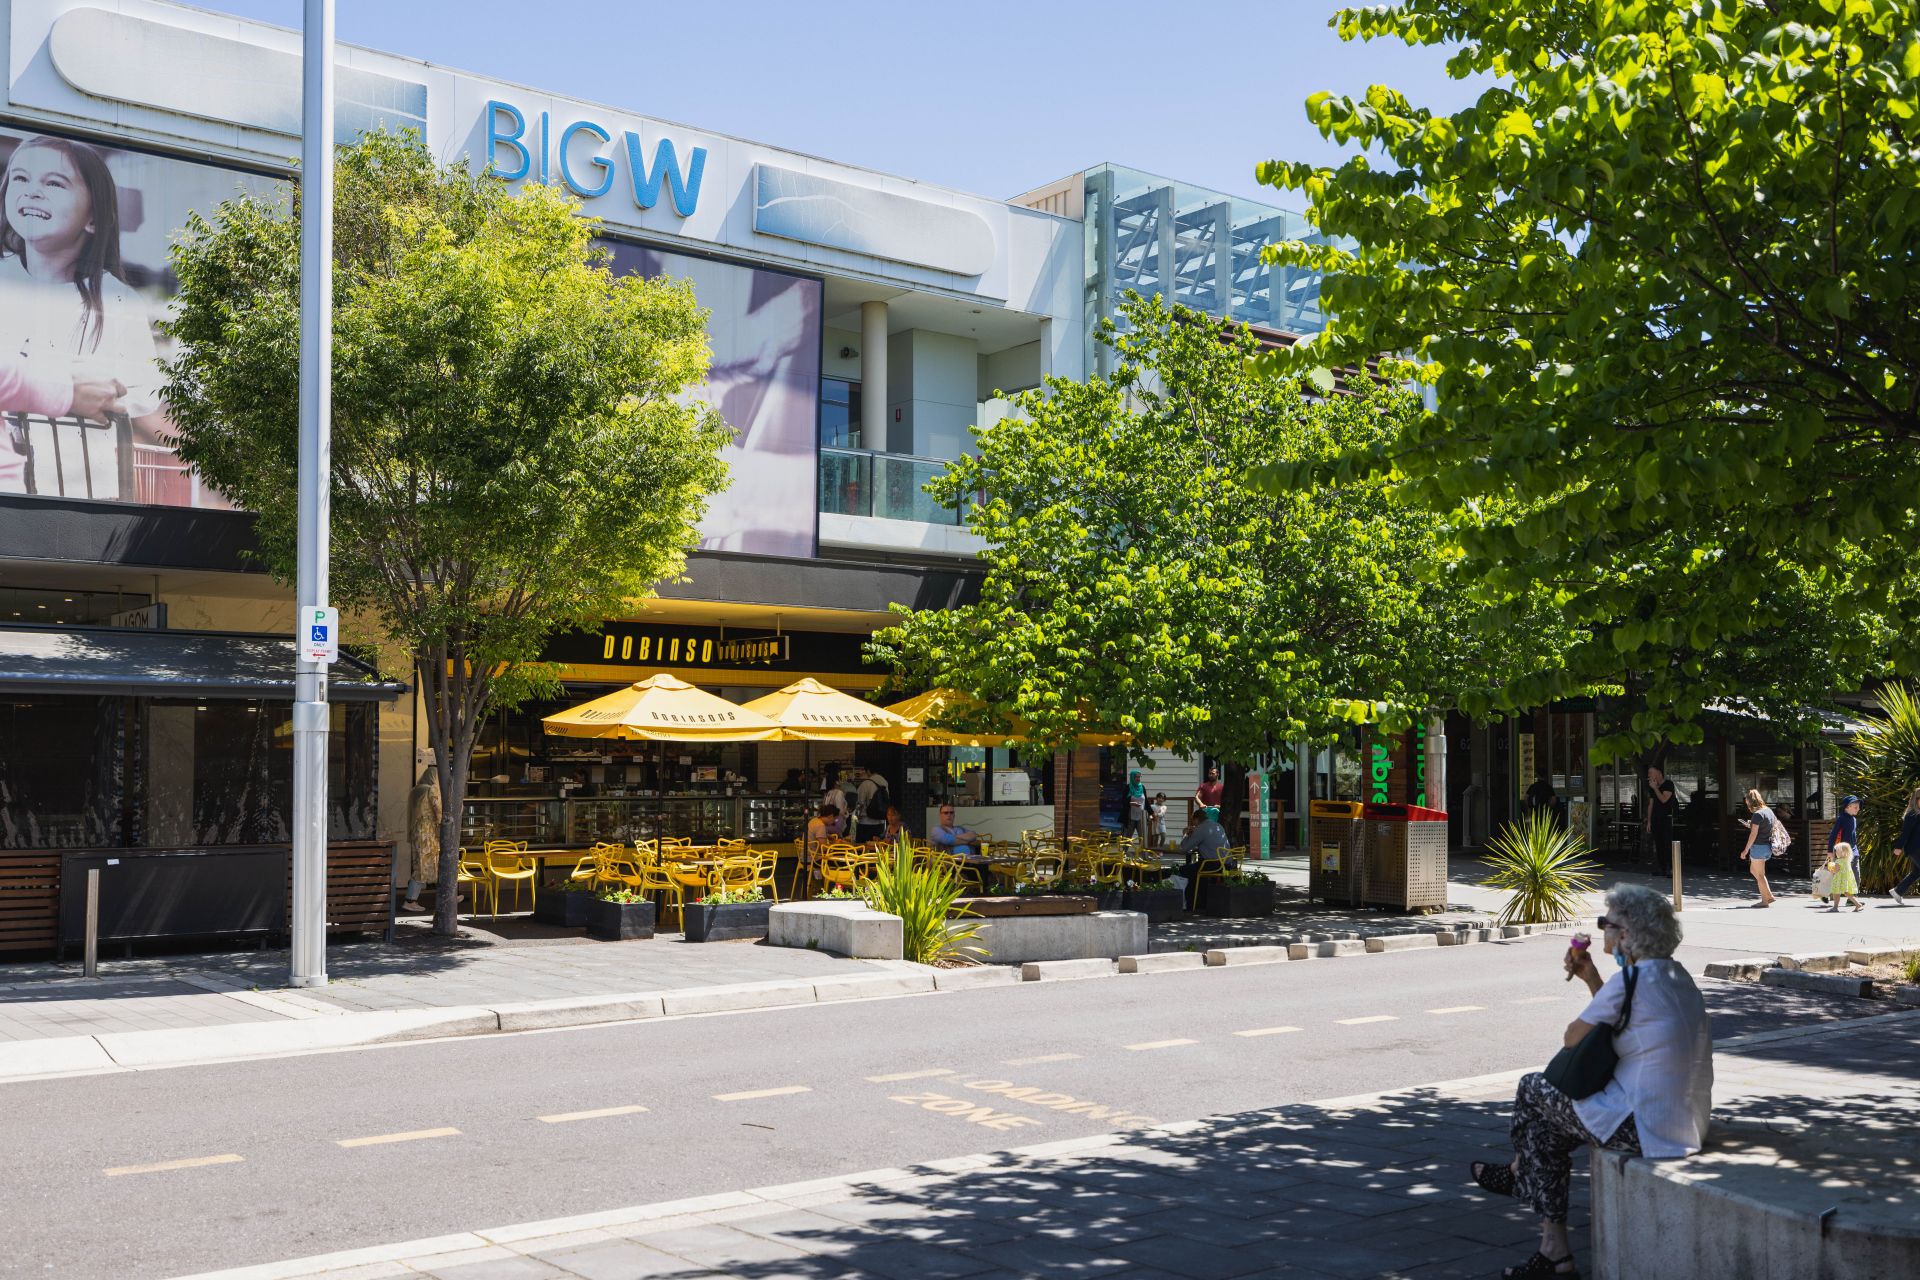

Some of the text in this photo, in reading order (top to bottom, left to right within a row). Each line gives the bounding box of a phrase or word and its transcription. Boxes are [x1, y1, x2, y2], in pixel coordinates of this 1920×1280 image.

[315, 611, 325, 623] P
[603, 634, 716, 664] DOBINSO
[651, 711, 736, 723] DOBINSONS
[802, 712, 879, 723] DOBINSONS
[888, 1092, 1045, 1131] ZONE
